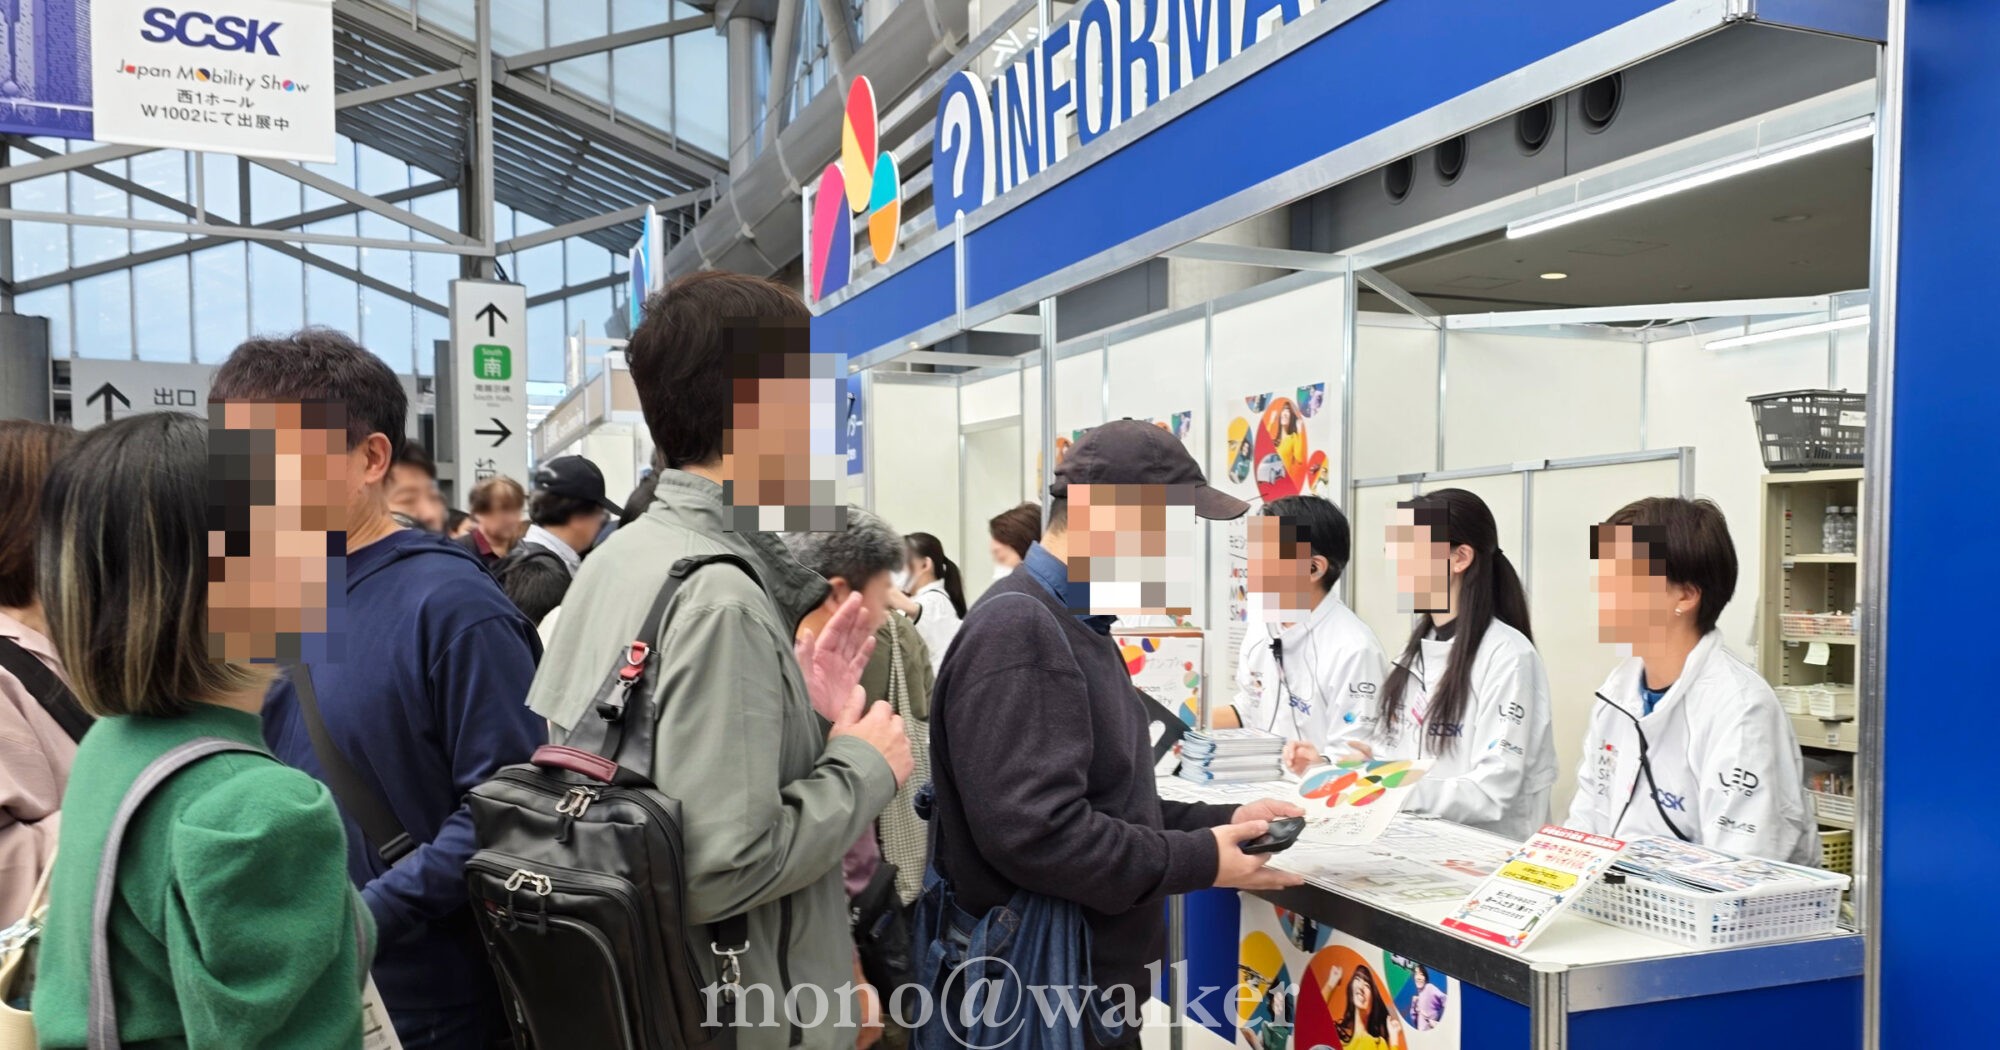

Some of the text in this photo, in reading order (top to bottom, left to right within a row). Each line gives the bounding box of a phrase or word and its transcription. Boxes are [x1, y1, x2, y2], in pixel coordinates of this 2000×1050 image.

[140, 7, 283, 57] SCSK
[116, 59, 310, 94] Japan Mobility Show
[176, 88, 255, 109] 西1ホール
[991, 0, 1304, 195] INFORM
[140, 103, 290, 132] W1002にて出展中
[483, 357, 502, 377] 南
[154, 387, 196, 406] 出口
[1499, 702, 1525, 720] LED
[1428, 722, 1464, 738] SCSK
[1718, 767, 1759, 789] LED
[1655, 788, 1687, 812] CSK
